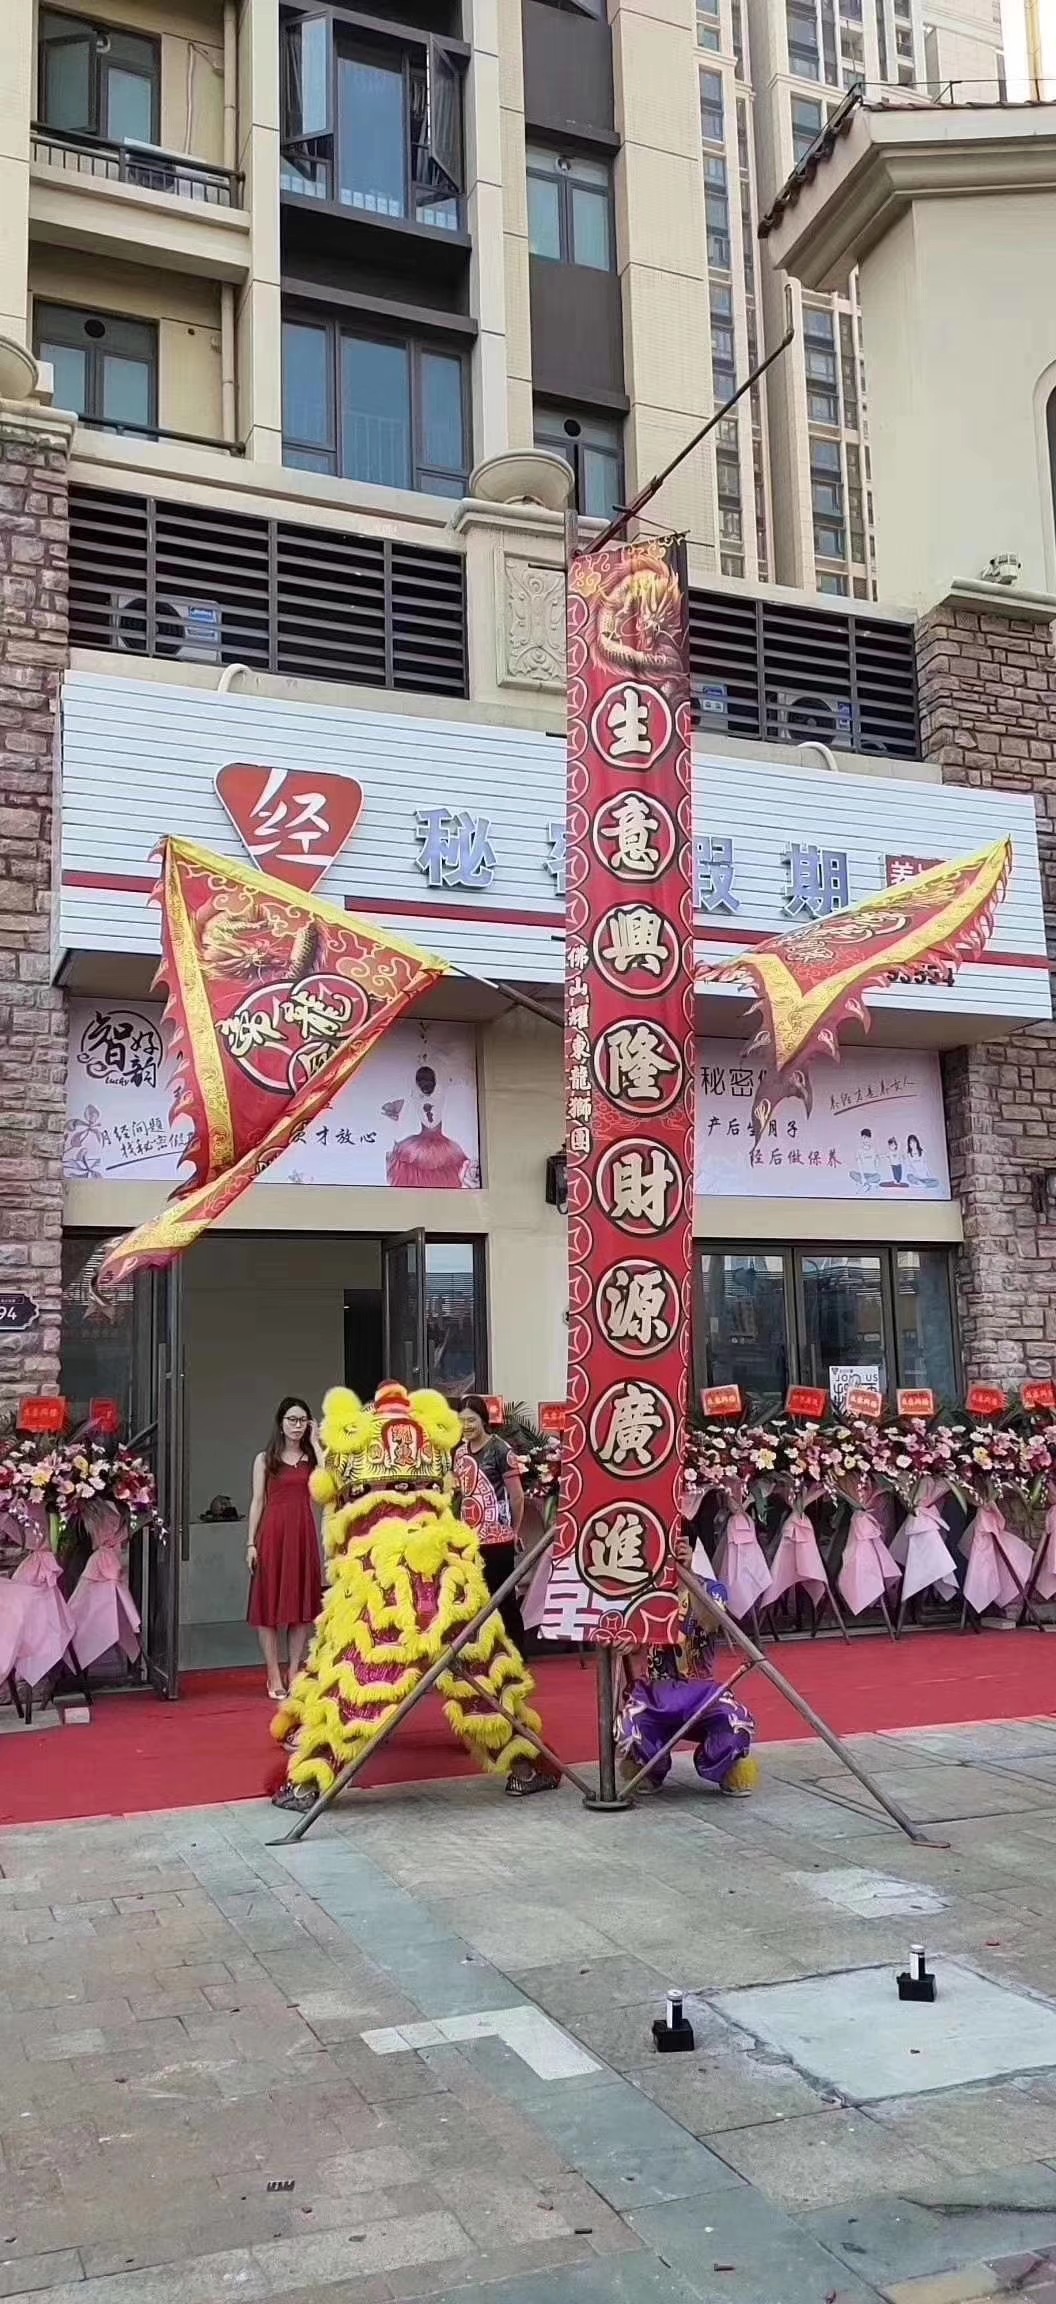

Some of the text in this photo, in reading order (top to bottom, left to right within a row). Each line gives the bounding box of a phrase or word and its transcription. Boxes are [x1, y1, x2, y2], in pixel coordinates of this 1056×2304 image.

[249, 767, 333, 866] 经
[414, 808, 850, 918] 秘假期
[567, 946, 592, 1153] 佛山耀東龍獅團
[701, 1066, 767, 1097] 秘密
[586, 689, 680, 1584] 生意興隆財源廣進
